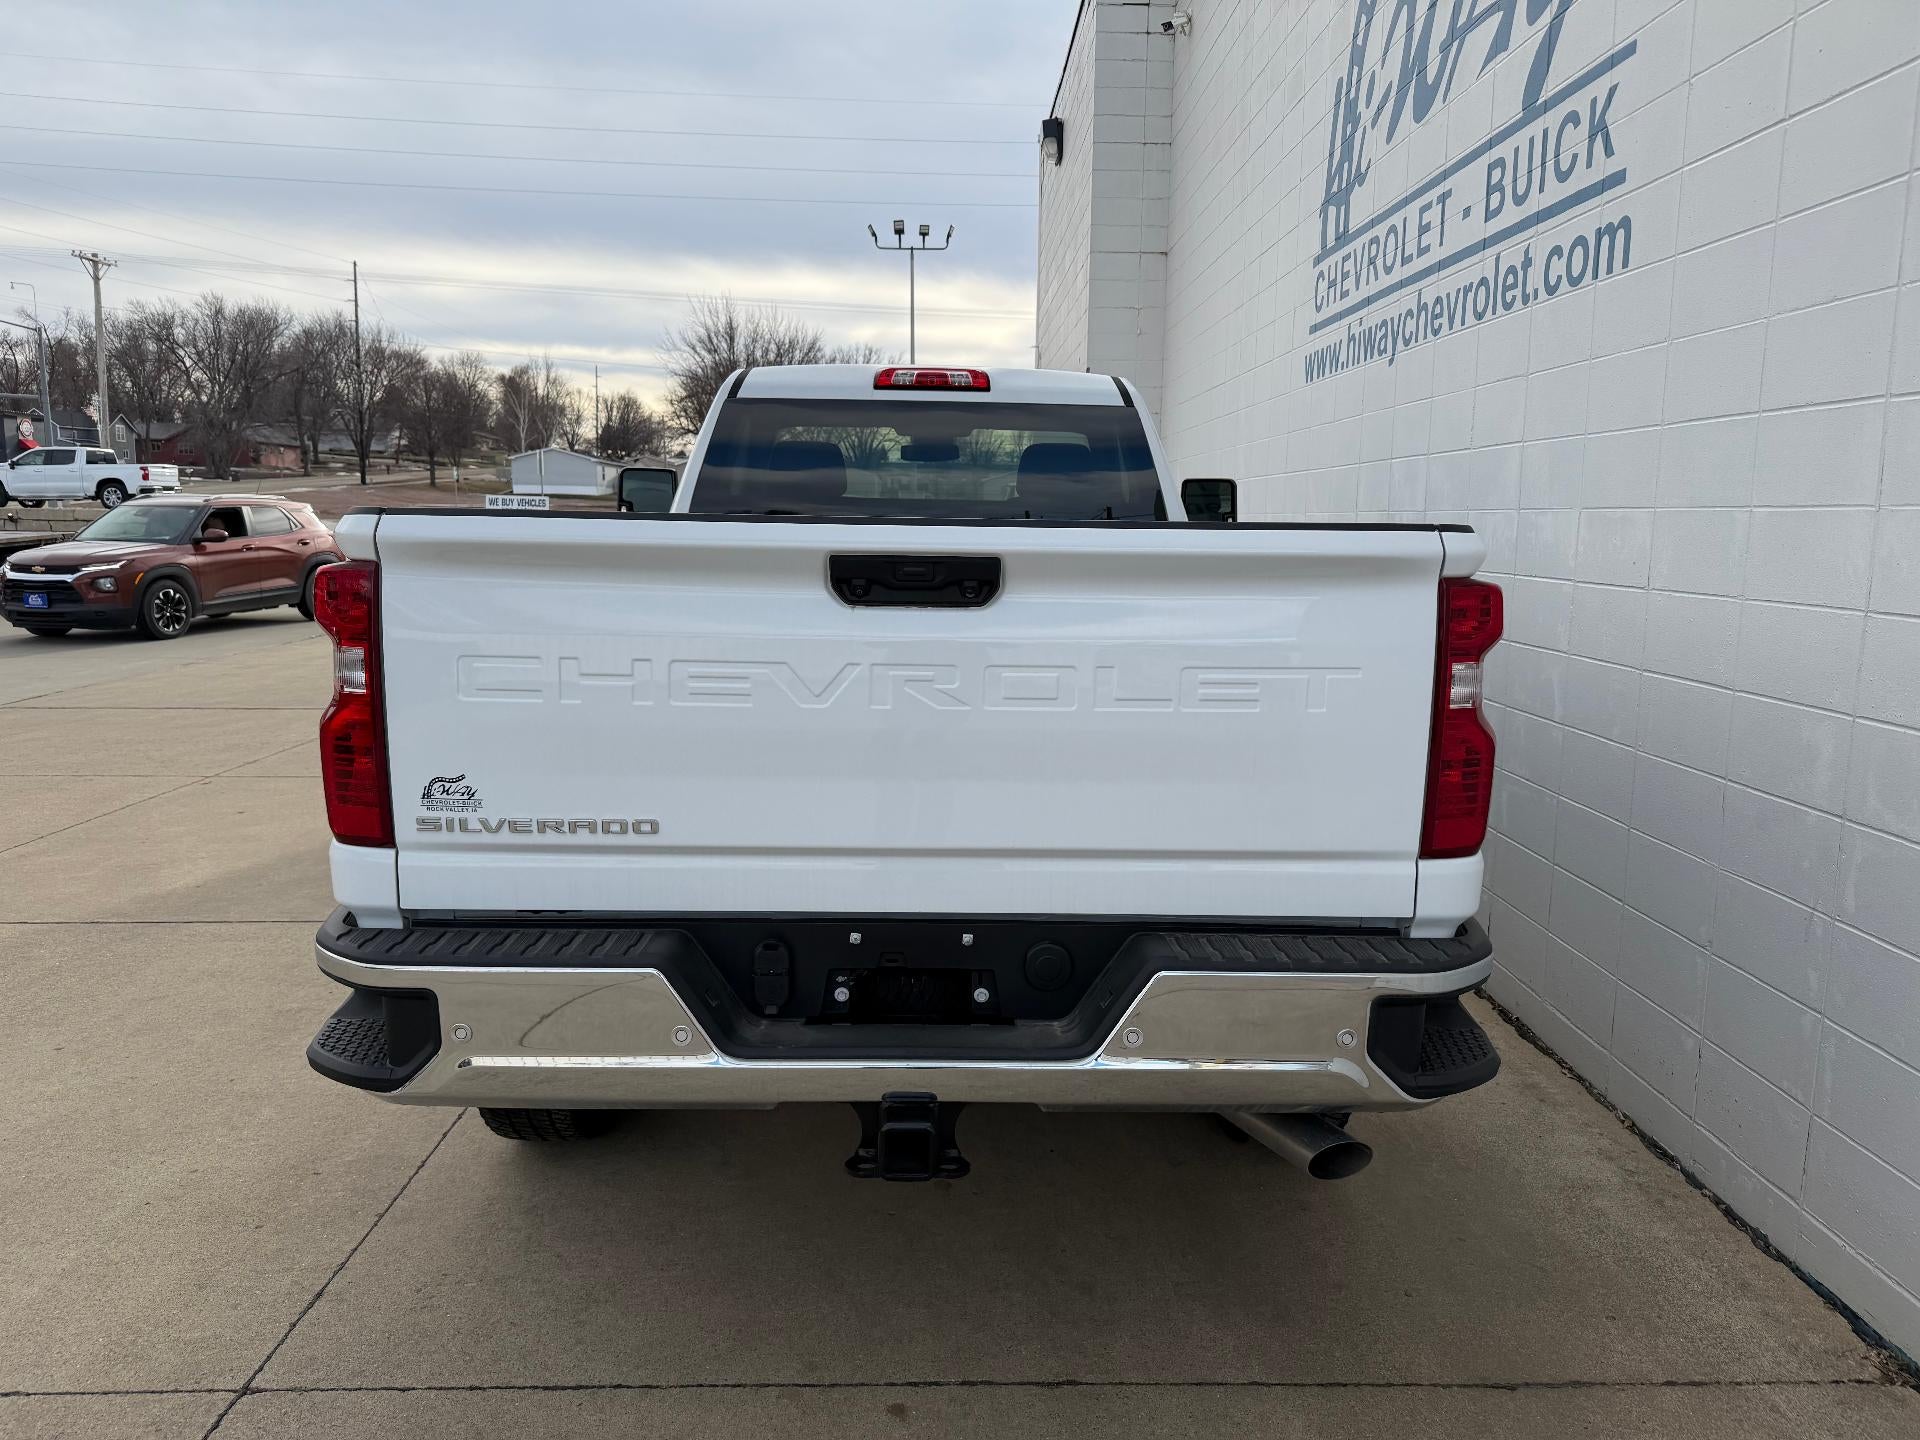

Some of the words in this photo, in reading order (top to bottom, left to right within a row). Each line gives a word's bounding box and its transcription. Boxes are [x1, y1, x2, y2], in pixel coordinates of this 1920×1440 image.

[1313, 188, 1453, 314] CHEVROLET
[1484, 82, 1620, 224] BUICK
[1304, 214, 1632, 384] www.hiwaychevrolet.com
[488, 497, 500, 507] WE
[501, 498, 515, 507] BUY
[517, 499, 547, 508] VEHICLES
[456, 655, 1363, 712] CHEVROLET
[416, 816, 660, 834] SILVERADO
